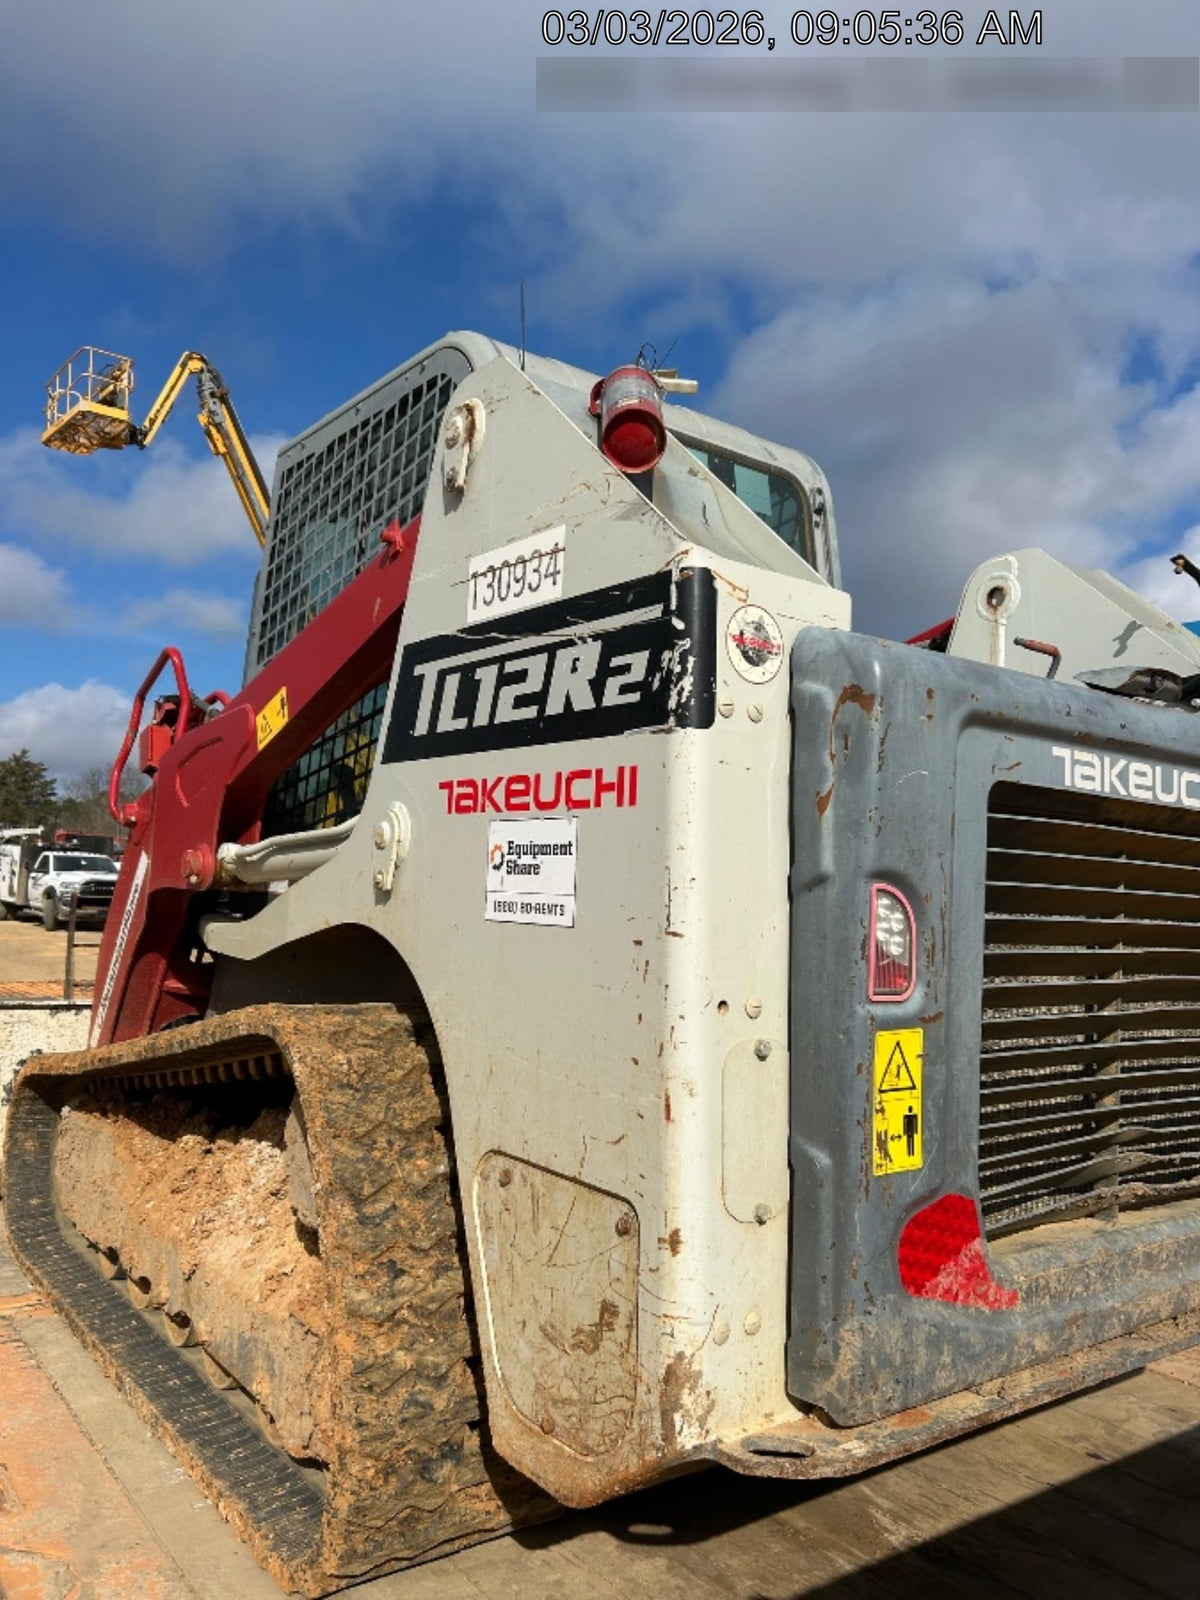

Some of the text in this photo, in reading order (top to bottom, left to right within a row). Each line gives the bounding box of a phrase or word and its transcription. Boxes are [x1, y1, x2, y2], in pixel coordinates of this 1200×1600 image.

[471, 542, 561, 611] T30934
[411, 604, 663, 737] TL12R2
[506, 840, 573, 859] Equipment
[506, 860, 541, 876] Share
